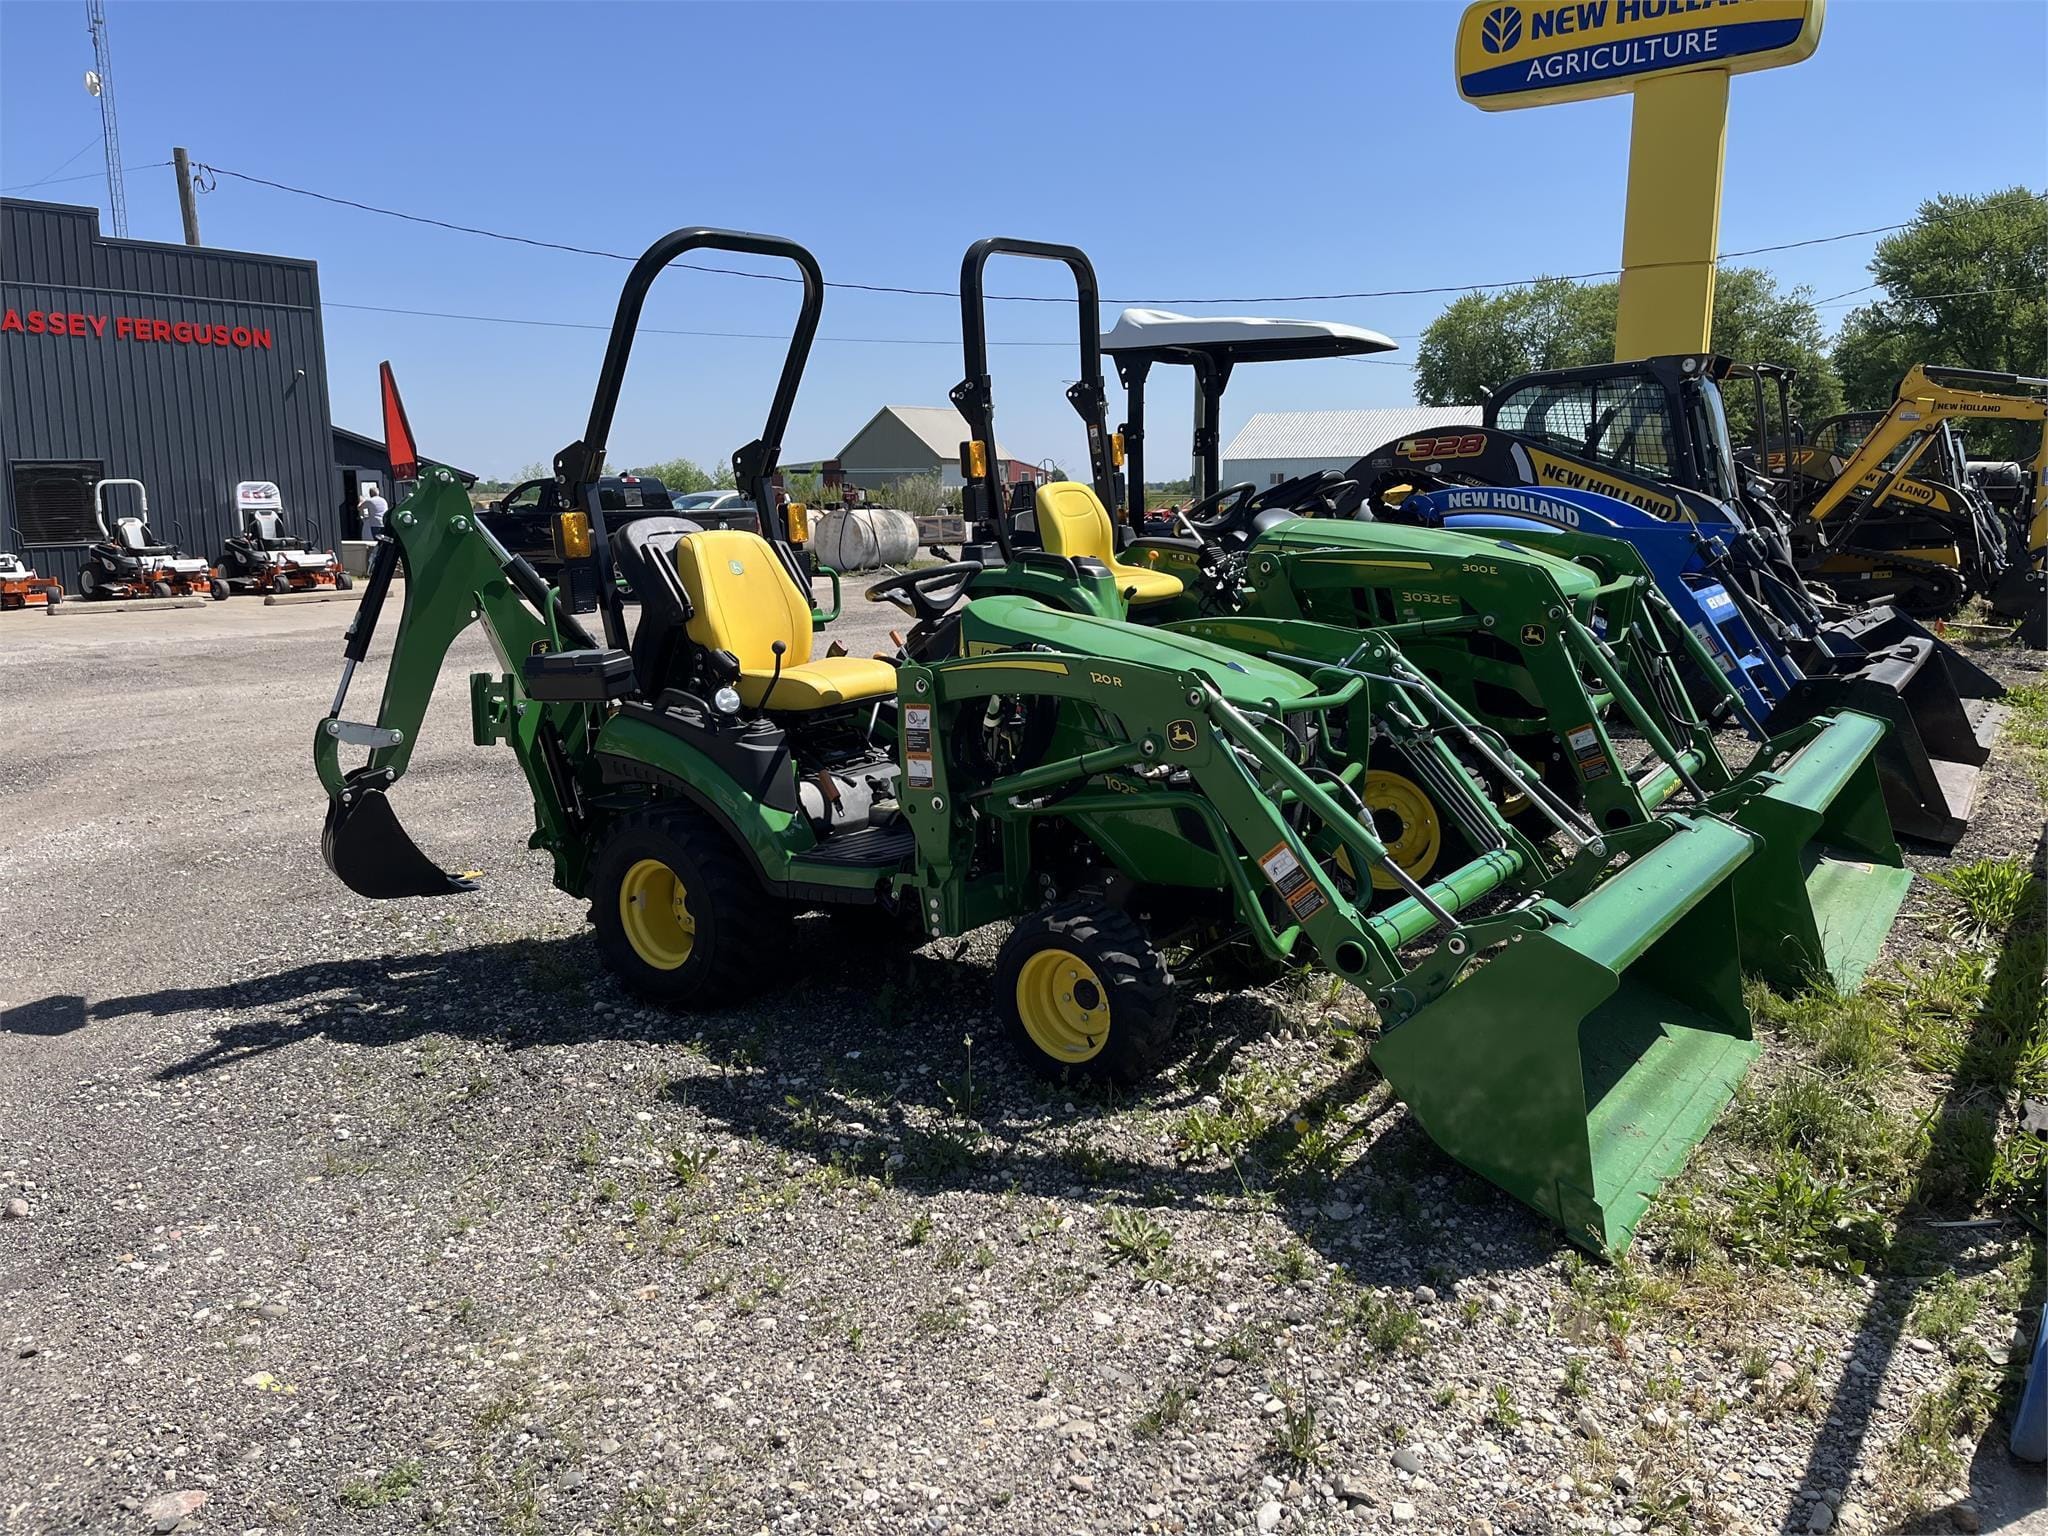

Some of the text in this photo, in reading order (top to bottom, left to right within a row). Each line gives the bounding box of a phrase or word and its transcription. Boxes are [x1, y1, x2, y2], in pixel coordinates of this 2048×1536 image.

[1531, 1, 1607, 40] NEW
[1526, 29, 1718, 81] AGRICULTURE
[1, 309, 272, 350] ASSEY FERGUSON
[1960, 404, 2000, 412] HOLLAND
[1448, 492, 1580, 527] NEW HOLLAND
[1542, 463, 1672, 519] NEW HOLLAND
